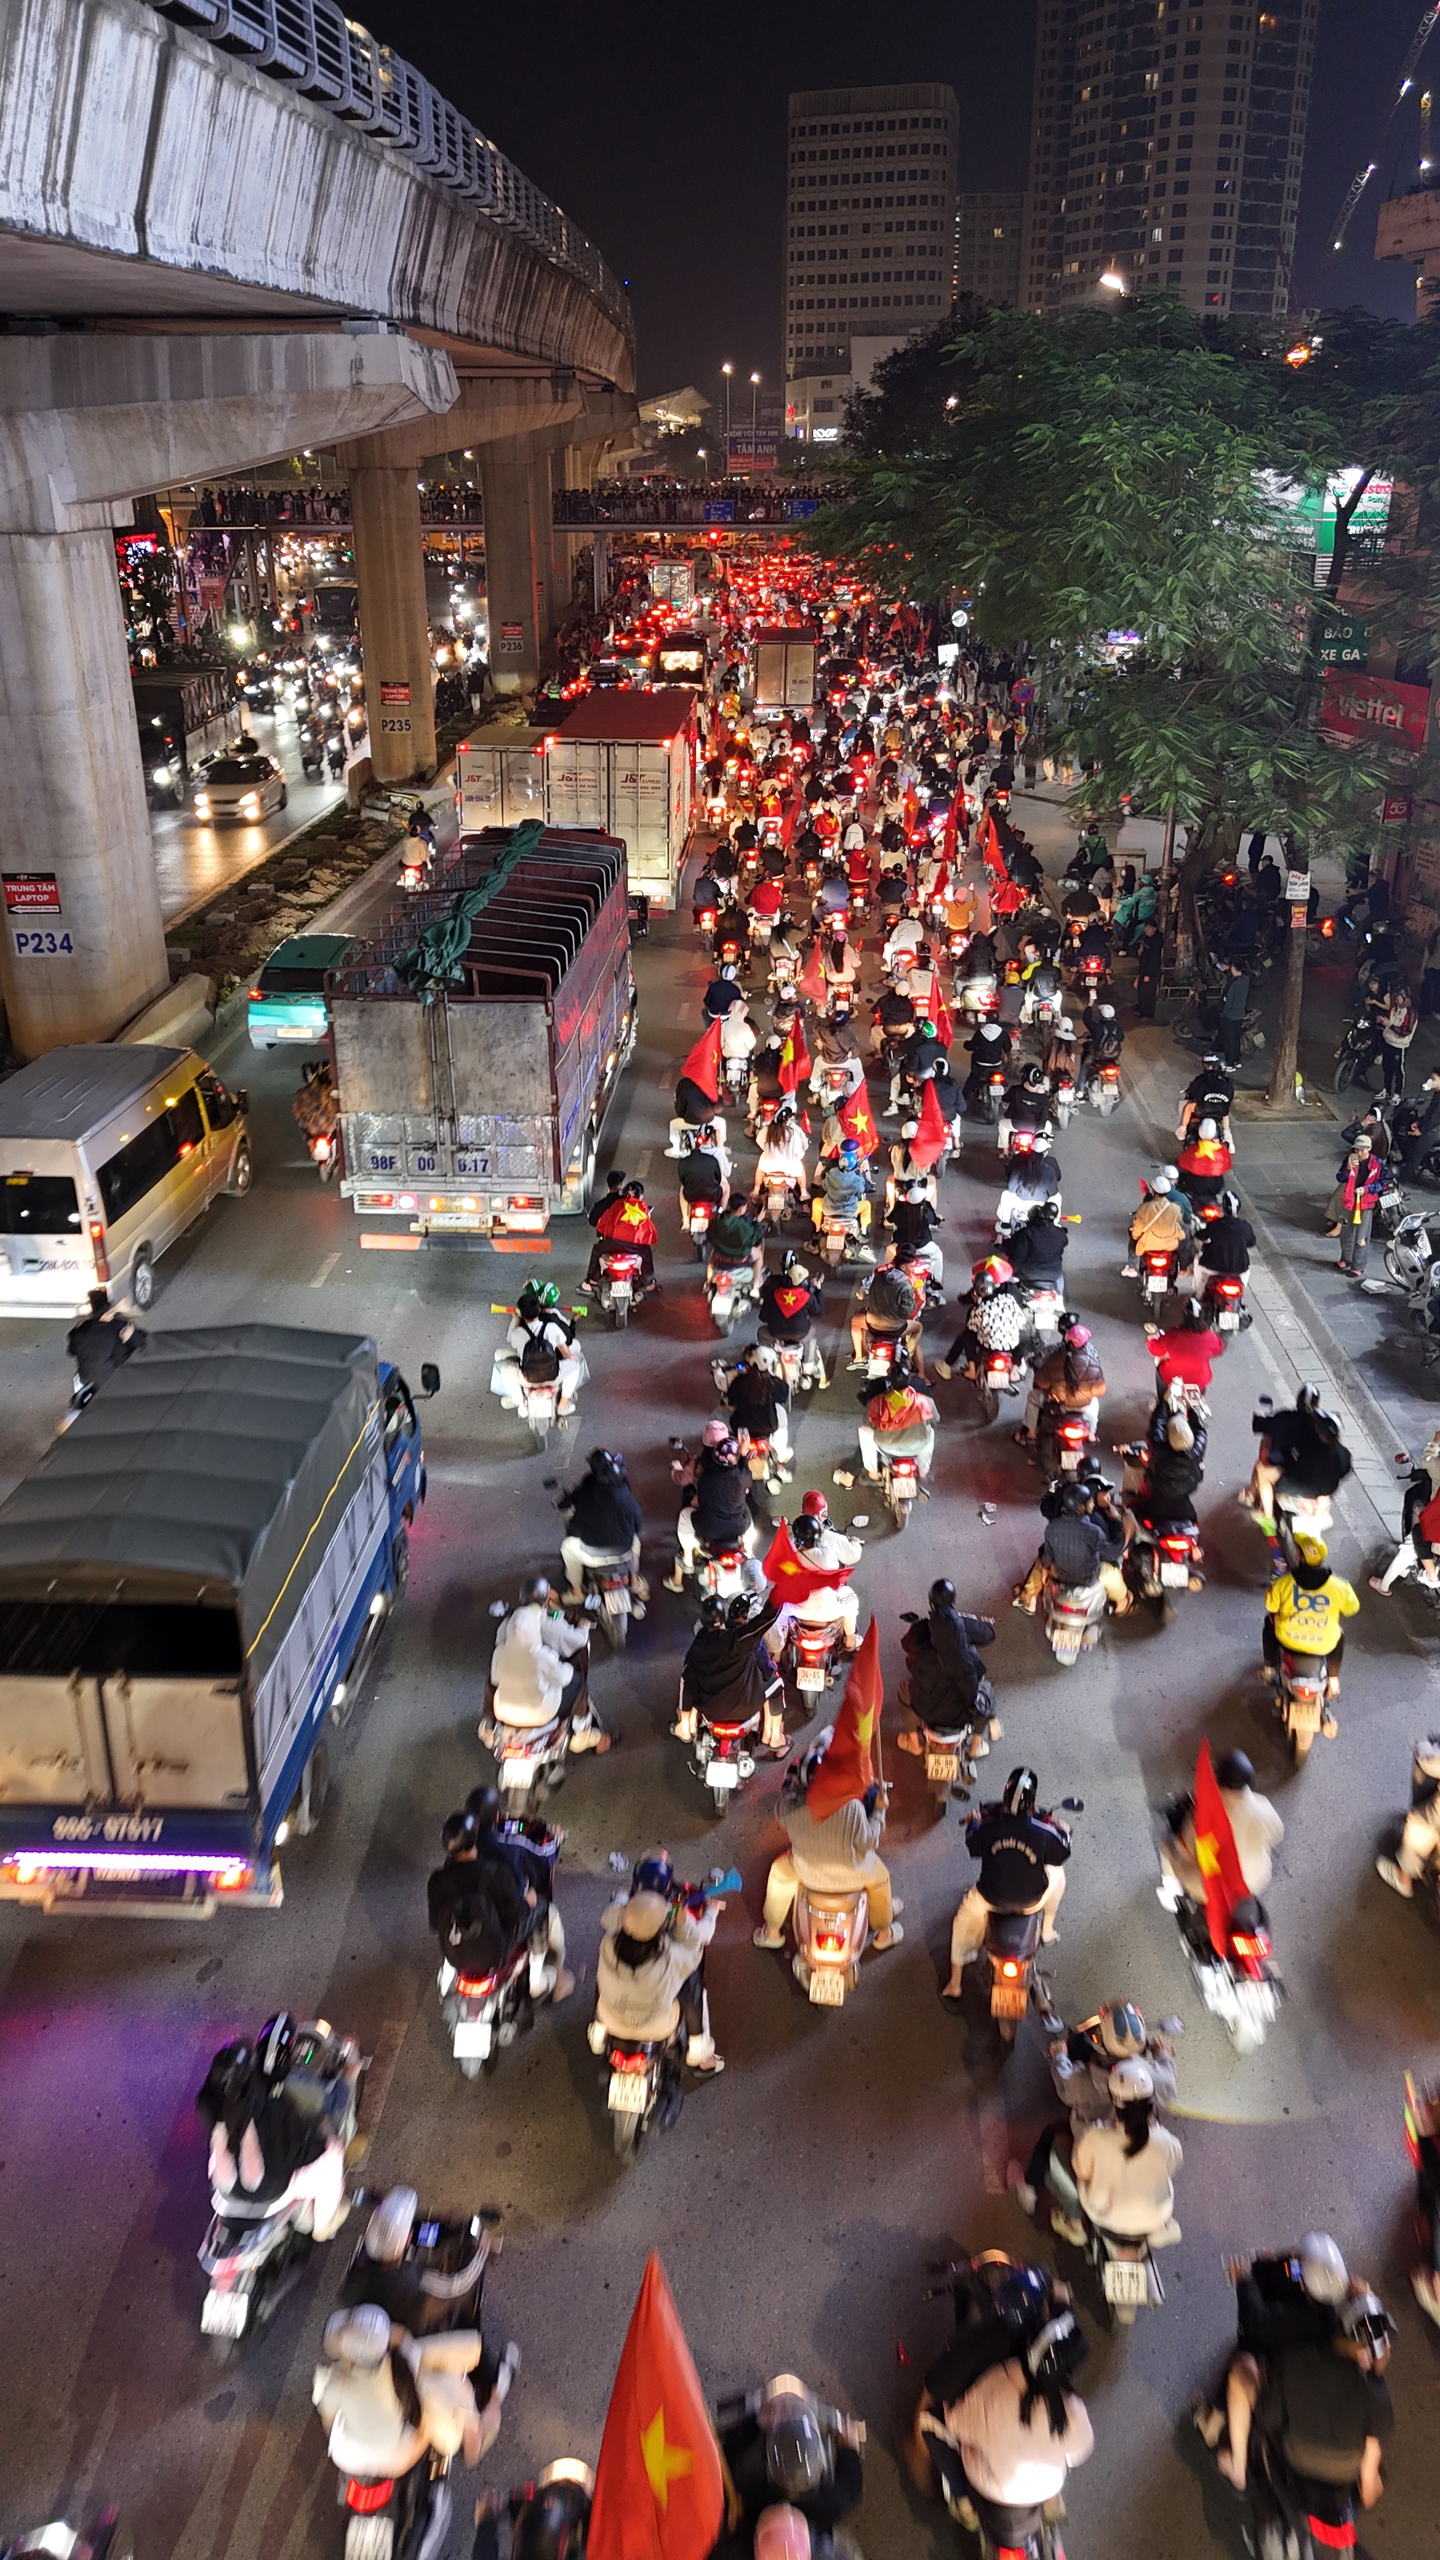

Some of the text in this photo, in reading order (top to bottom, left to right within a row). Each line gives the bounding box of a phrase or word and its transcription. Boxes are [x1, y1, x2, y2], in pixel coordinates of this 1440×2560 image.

[736, 442, 776, 455] TÂM ANH
[500, 642, 523, 651] P236
[1319, 649, 1337, 661] XE
[1341, 649, 1361, 661] GA
[381, 719, 412, 732] P235
[464, 774, 482, 783] J&T
[557, 772, 583, 782] J&T
[620, 773, 647, 783] J&T
[1388, 801, 1408, 815] 5G
[5, 882, 56, 892] TRUNG TÂM
[14, 894, 50, 902] LAPTOP
[15, 932, 74, 954] P234
[1293, 1584, 1331, 1613] be
